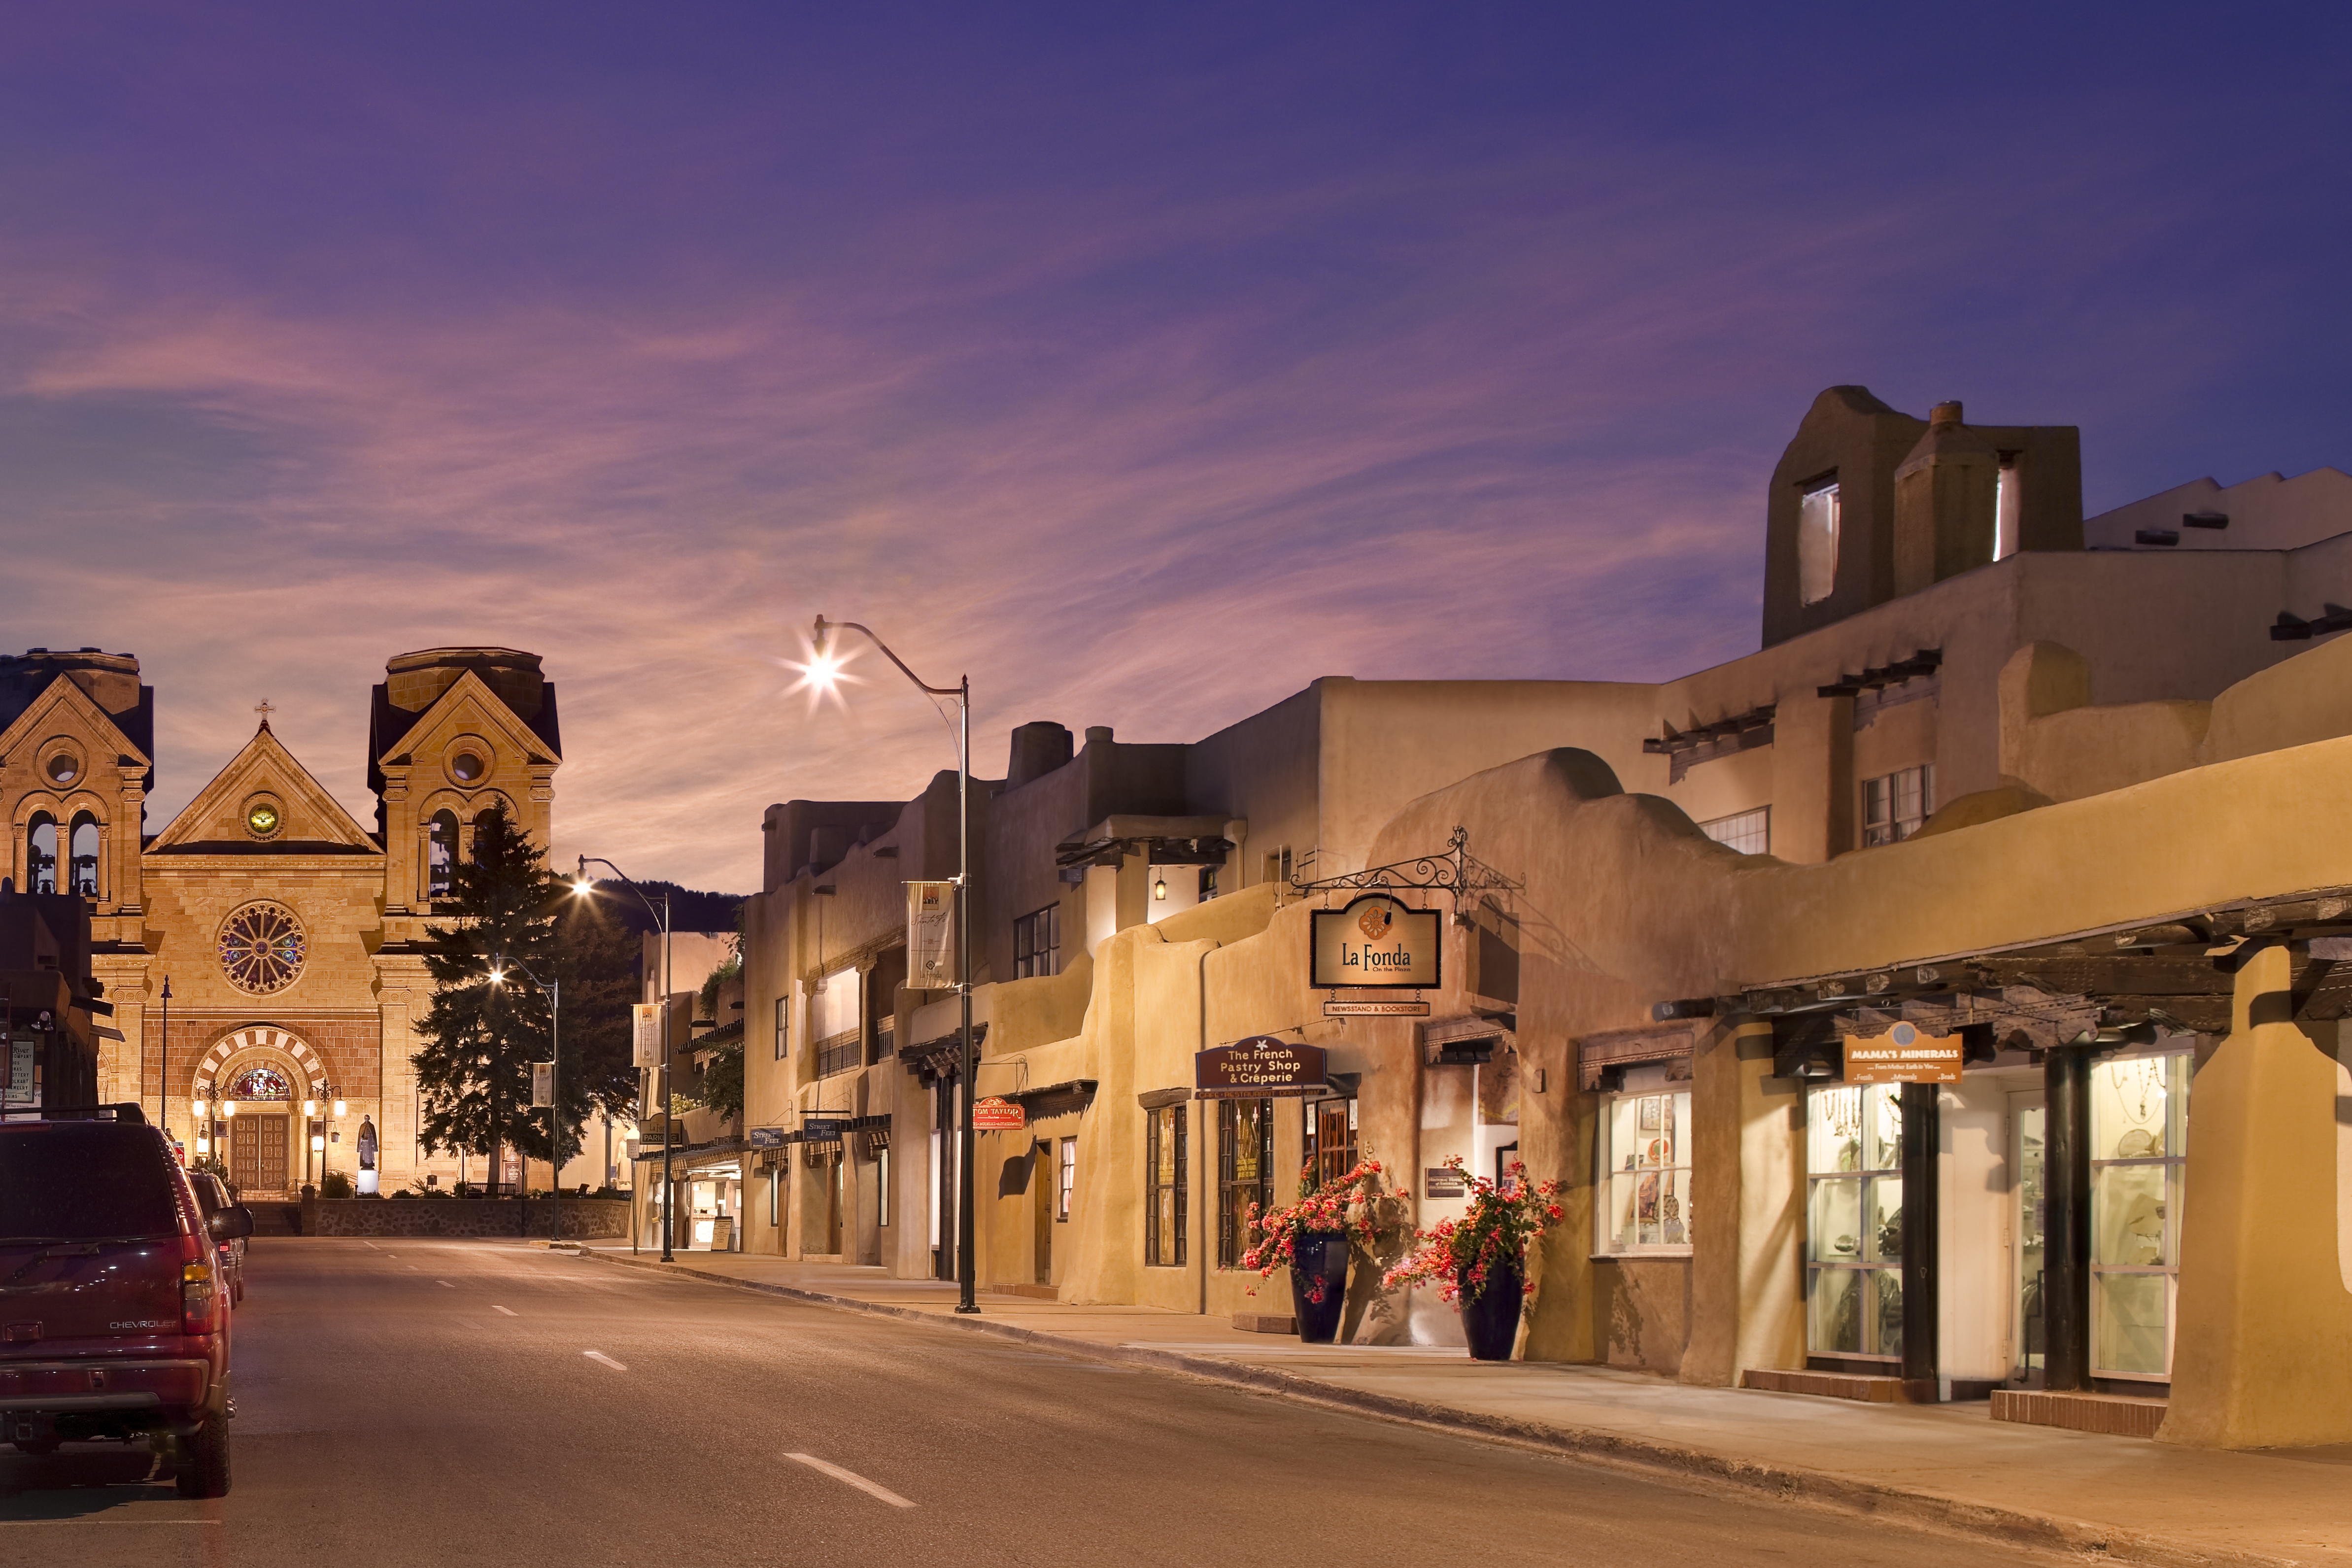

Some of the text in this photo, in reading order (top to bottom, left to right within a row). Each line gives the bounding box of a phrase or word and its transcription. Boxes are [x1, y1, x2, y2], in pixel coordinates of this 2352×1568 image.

[1342, 943, 1411, 971] La Fonda
[1227, 1049, 1293, 1060] The French
[1851, 1050, 1958, 1059] MAMA'S MINERALS
[1221, 1060, 1300, 1073] Pastry Shop
[1230, 1073, 1237, 1083] &
[973, 1108, 989, 1117] TOM
[990, 1108, 1022, 1119] TAYLOR
[110, 1320, 176, 1329] CHEVROLET
